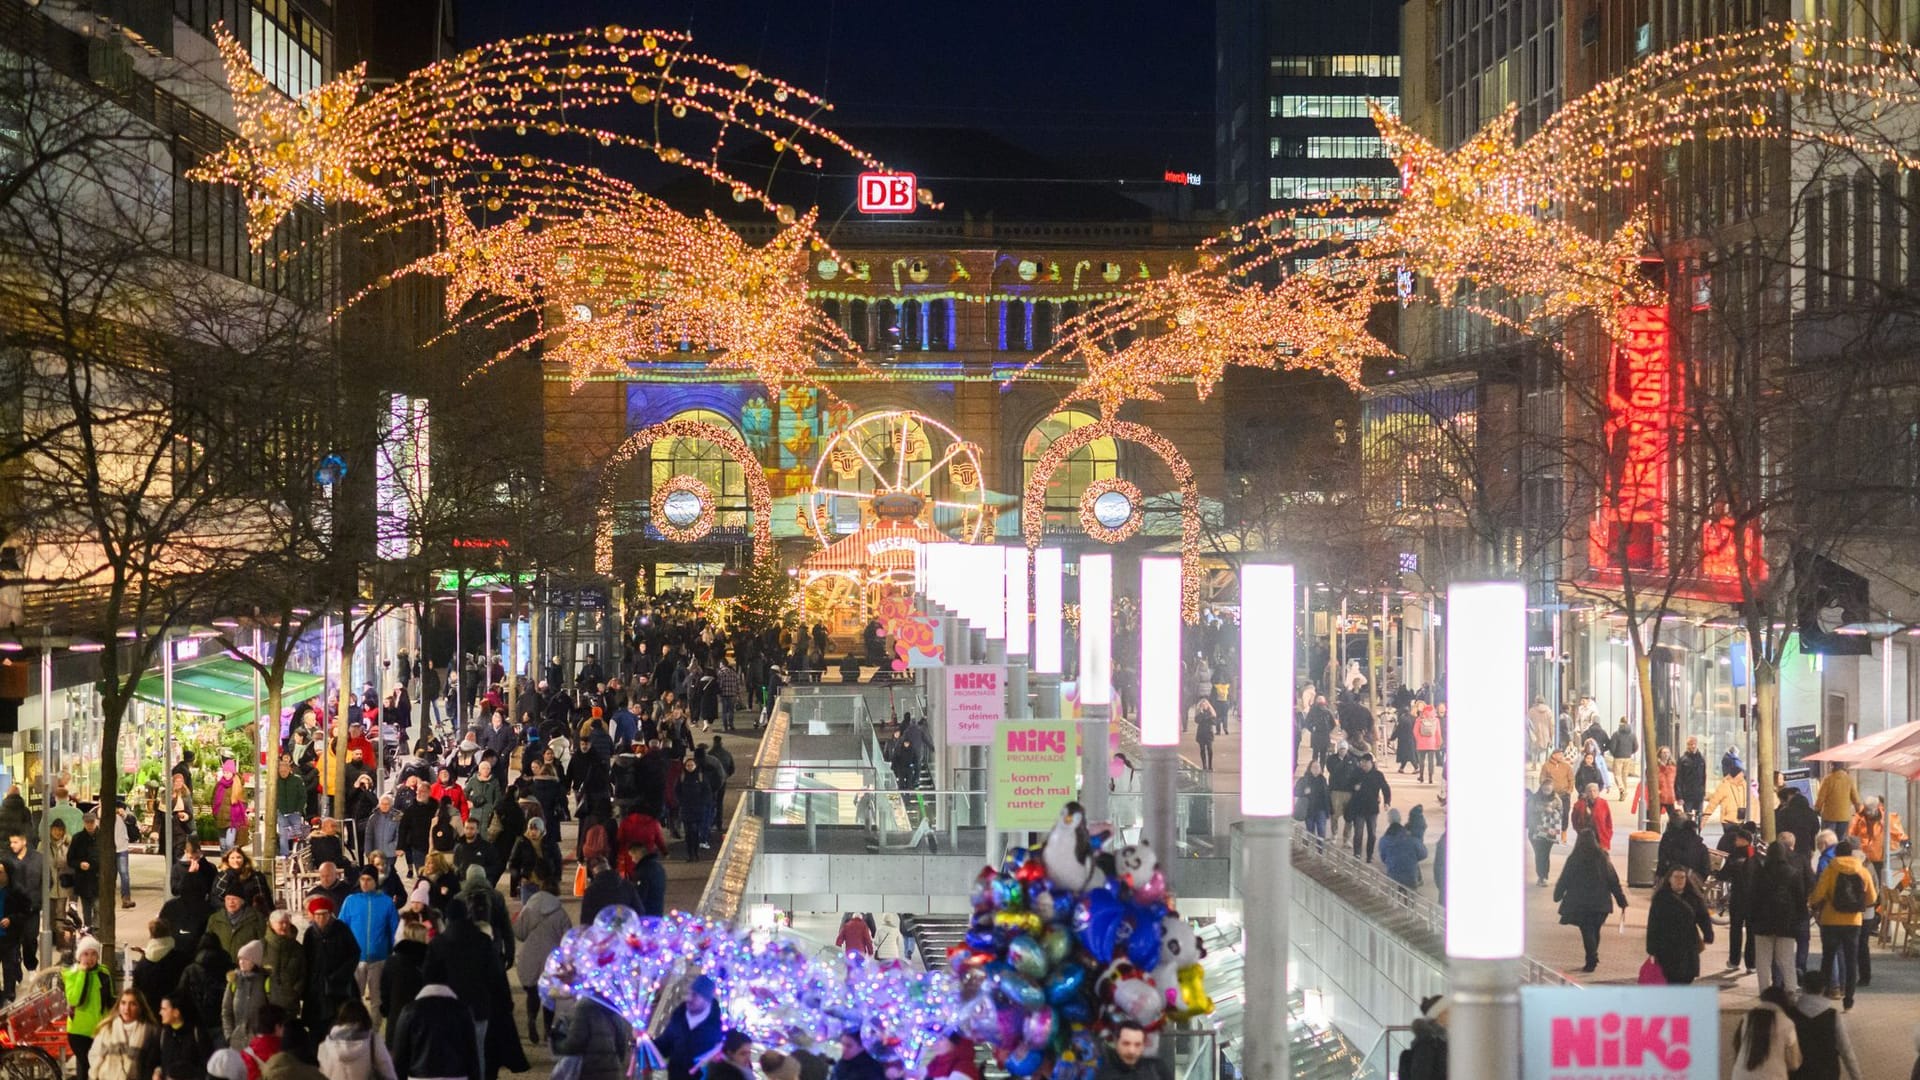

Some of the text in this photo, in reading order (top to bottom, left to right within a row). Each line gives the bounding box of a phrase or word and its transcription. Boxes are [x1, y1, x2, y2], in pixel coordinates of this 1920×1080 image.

[866, 180, 910, 206] DB
[968, 712, 999, 720] deinen
[958, 722, 980, 731] Style
[1006, 754, 1066, 763] PROMENADE
[1014, 785, 1071, 796] doch mal
[1007, 801, 1045, 809] runter
